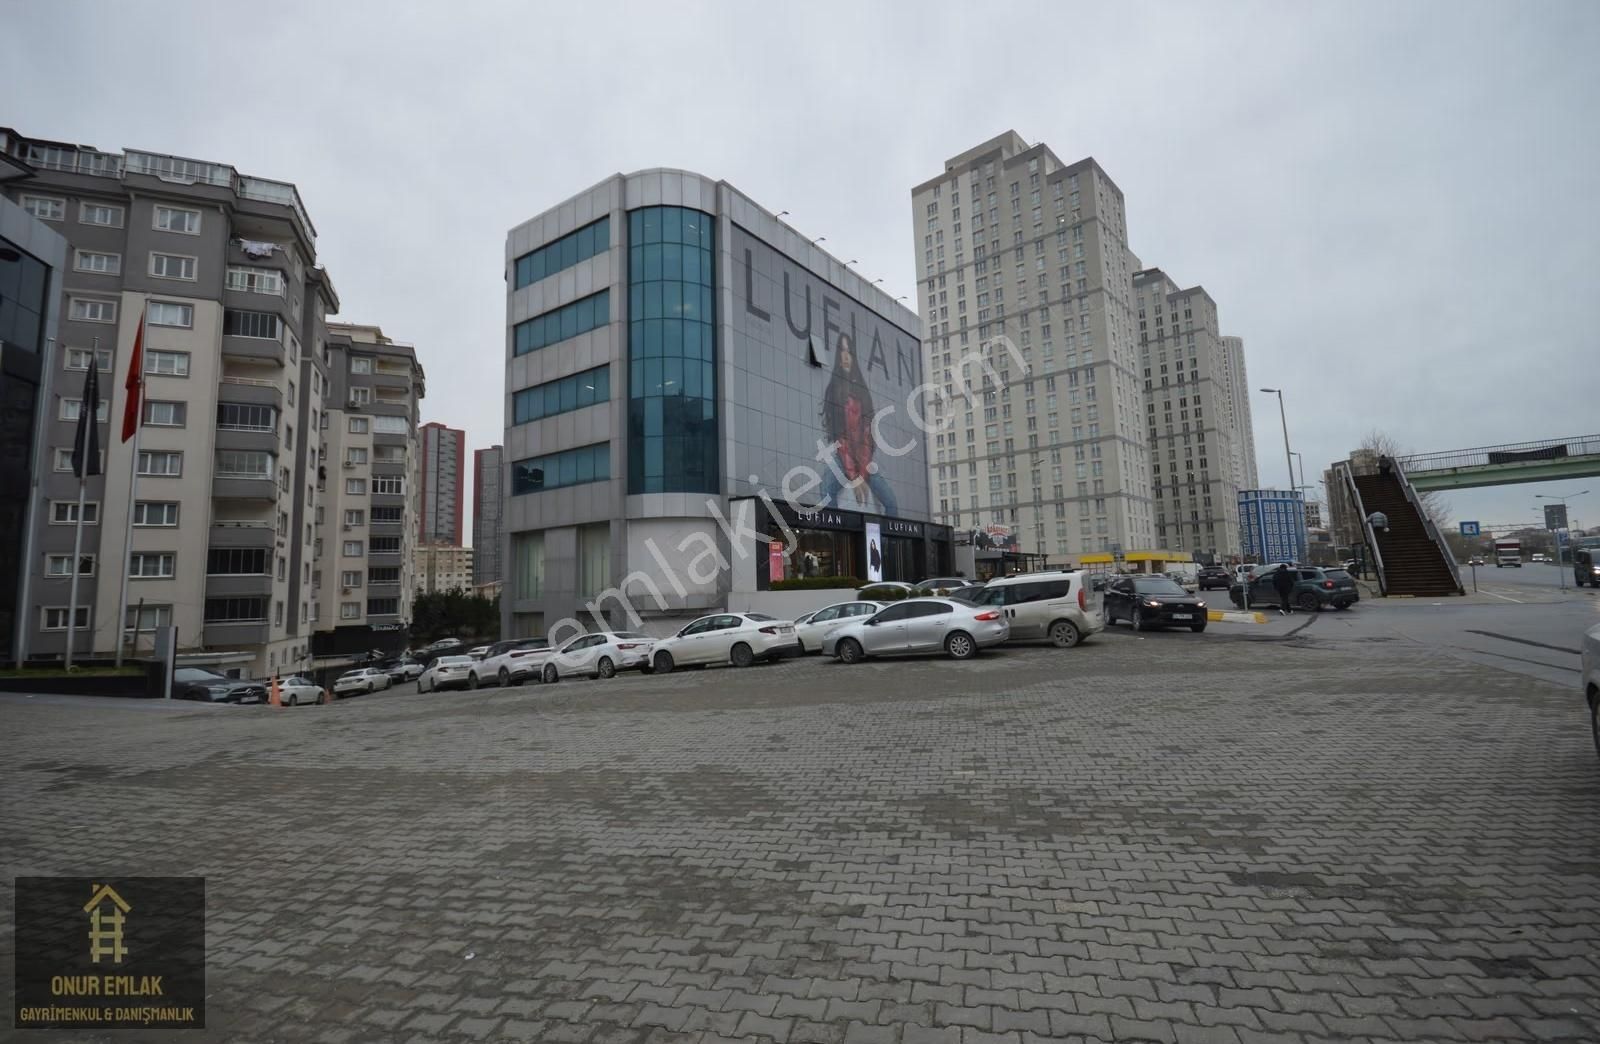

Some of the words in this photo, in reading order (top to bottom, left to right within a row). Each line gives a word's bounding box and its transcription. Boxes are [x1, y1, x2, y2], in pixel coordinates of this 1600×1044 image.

[745, 248, 915, 388] LUFIAN
[798, 511, 842, 525] LUFIAN
[889, 521, 918, 533] LUFIAN
